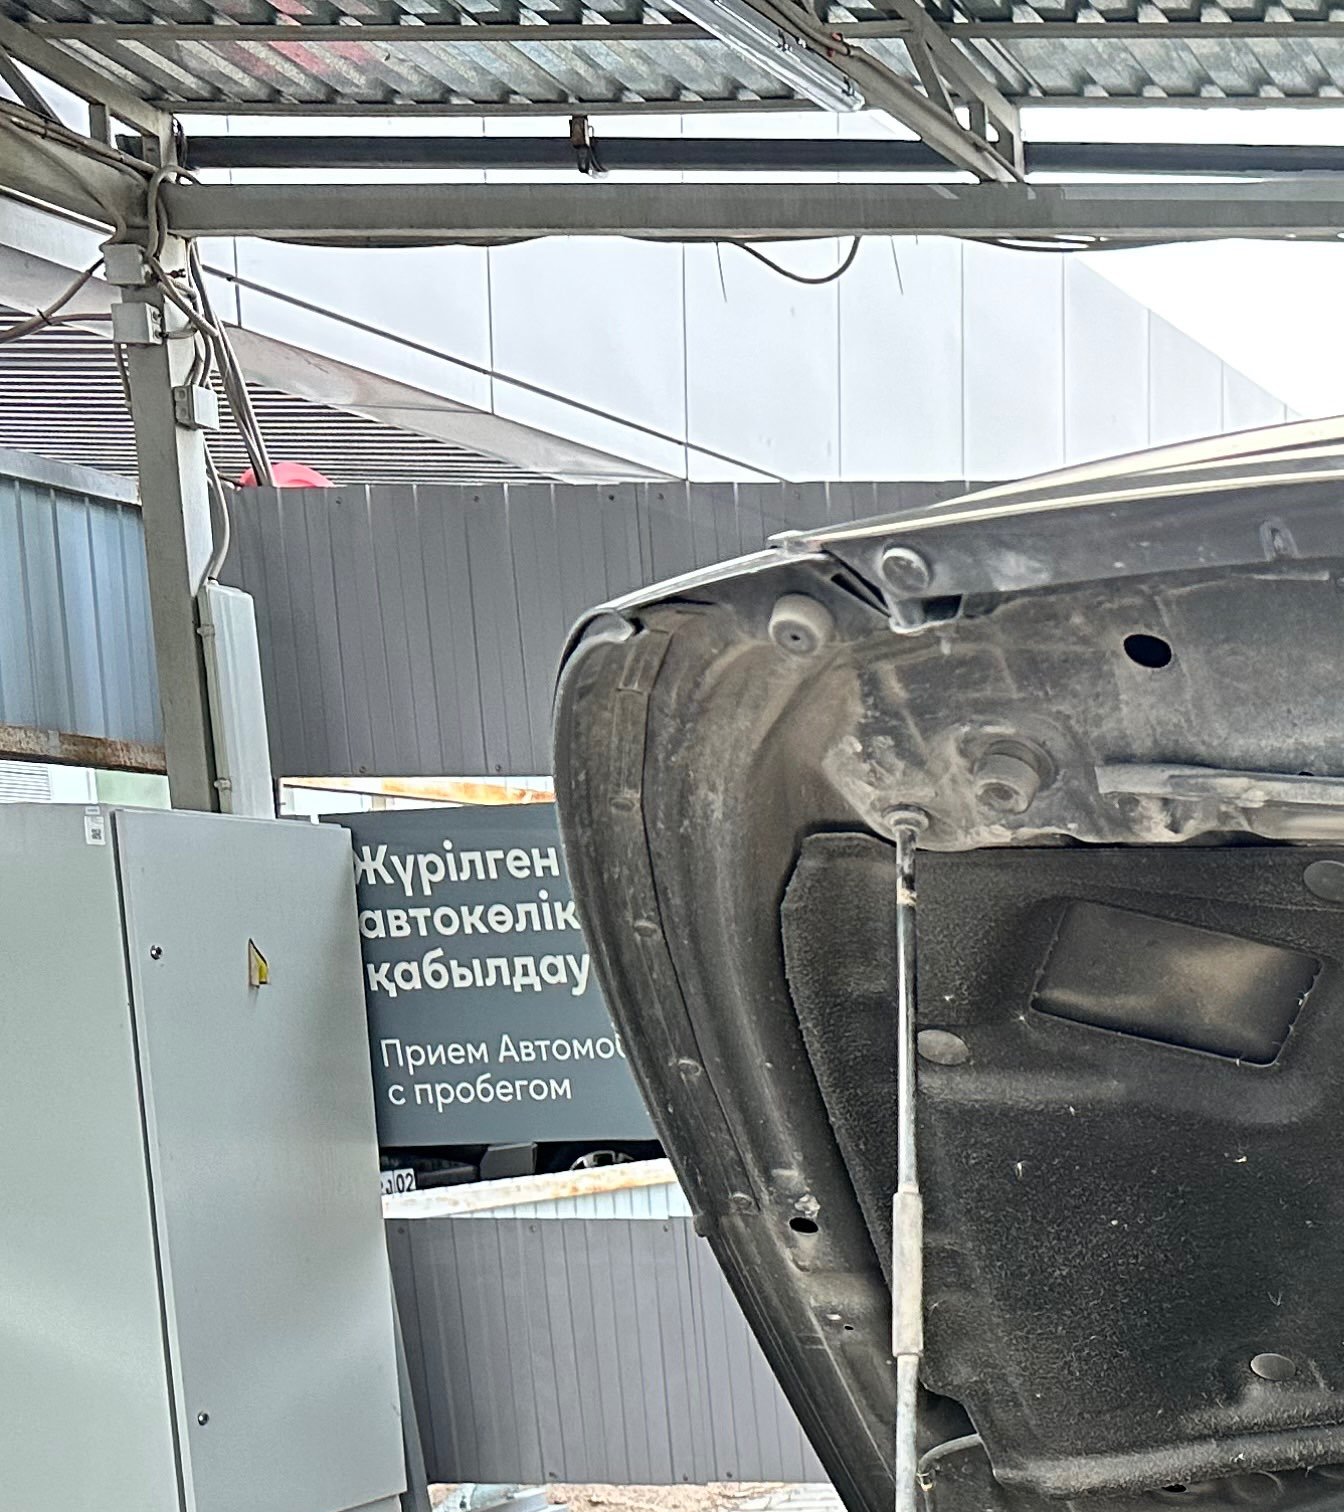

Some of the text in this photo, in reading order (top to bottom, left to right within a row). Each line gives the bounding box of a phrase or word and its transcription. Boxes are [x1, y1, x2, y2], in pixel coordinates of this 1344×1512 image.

[354, 839, 560, 896] Жүрілген
[366, 948, 590, 997] қабылдау
[381, 1035, 489, 1075] Прием
[388, 1073, 573, 1112] с пробегом
[396, 1172, 414, 1194] 02
